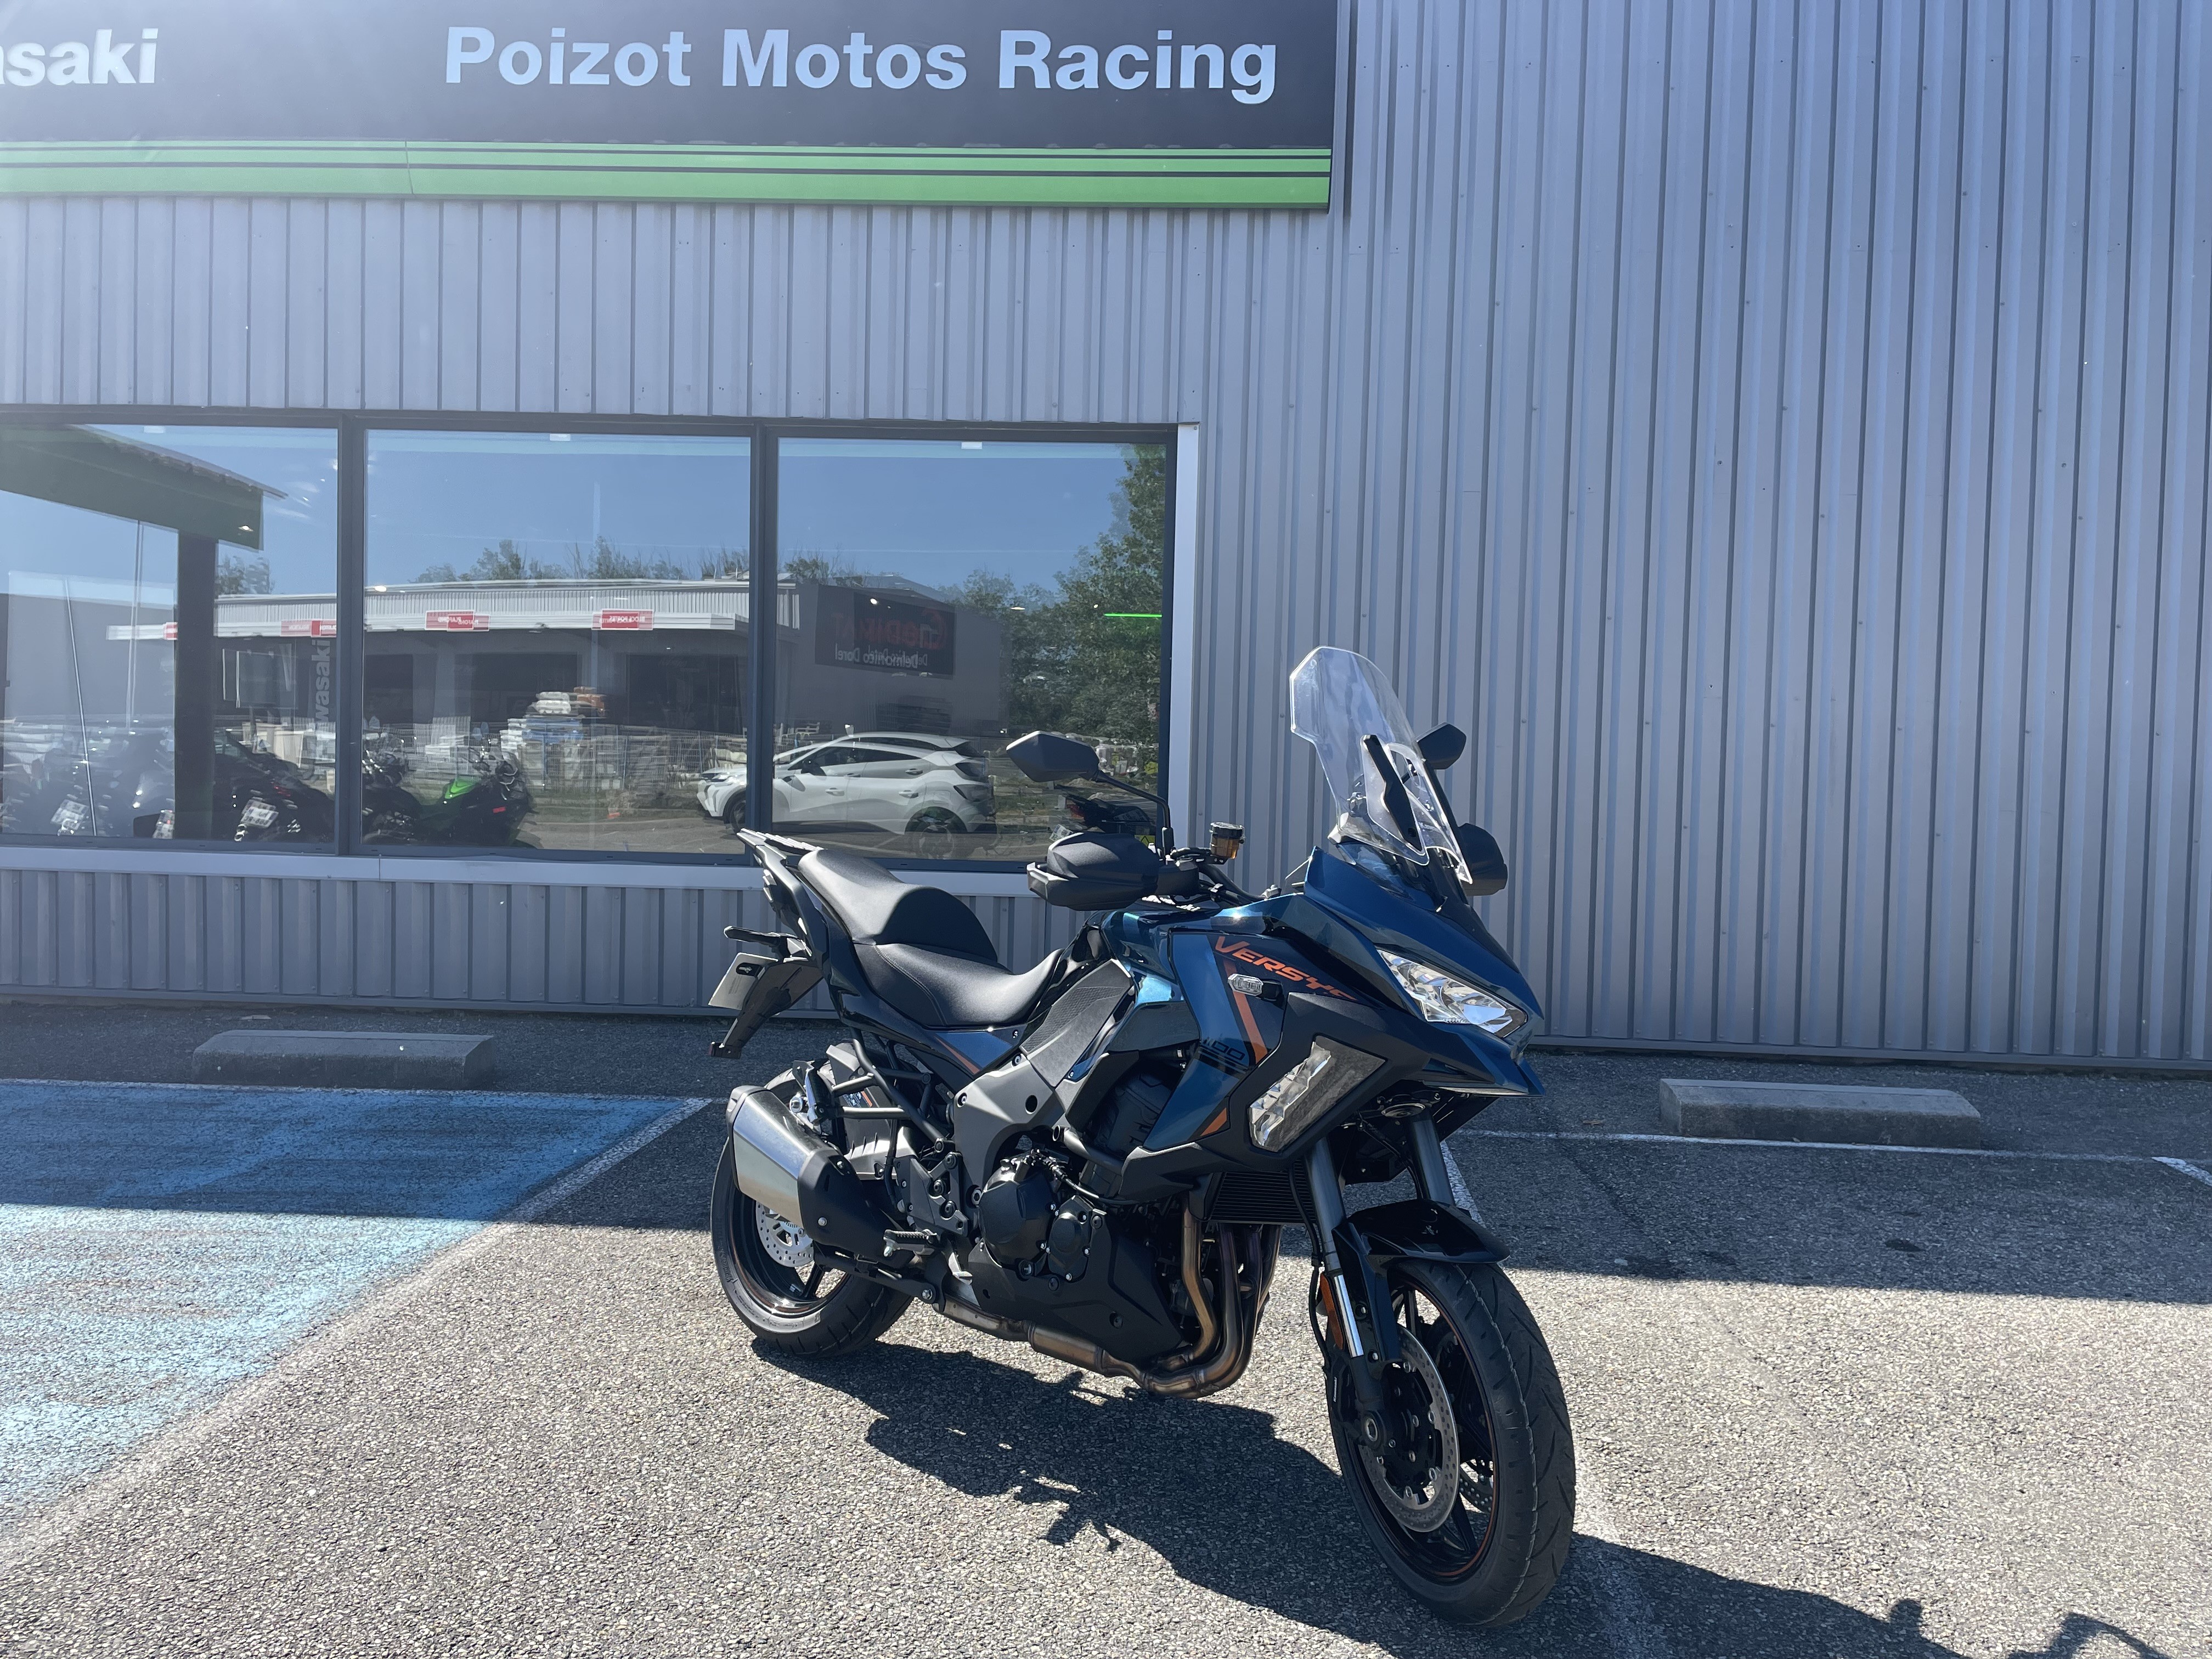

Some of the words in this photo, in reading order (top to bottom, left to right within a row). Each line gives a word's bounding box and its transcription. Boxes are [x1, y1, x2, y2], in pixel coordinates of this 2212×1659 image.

[0, 28, 159, 87] saki
[446, 26, 692, 87] Poizot
[722, 29, 967, 90] Motos
[998, 29, 1278, 105] Racing
[311, 639, 330, 723] wasaki
